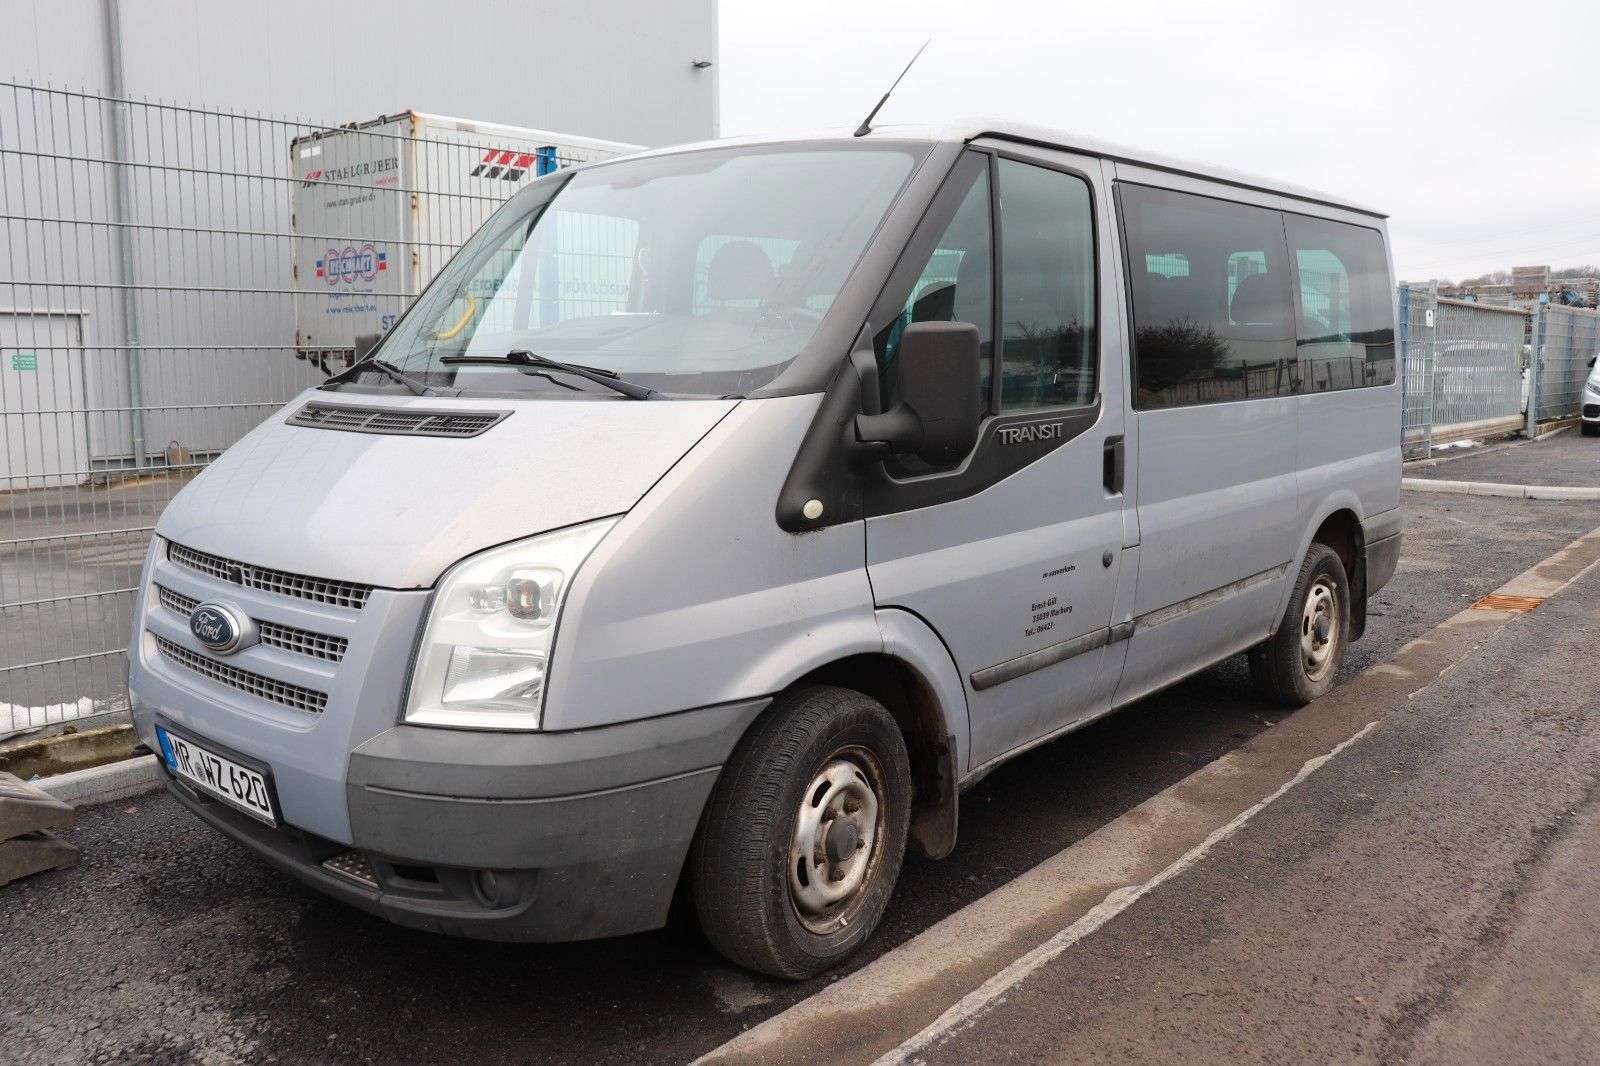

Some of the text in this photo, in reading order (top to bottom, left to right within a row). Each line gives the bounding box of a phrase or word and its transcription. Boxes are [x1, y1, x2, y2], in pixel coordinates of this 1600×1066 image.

[998, 422, 1064, 445] TRANSIT
[195, 611, 223, 641] Ford
[168, 736, 270, 813] MR WZ 620
